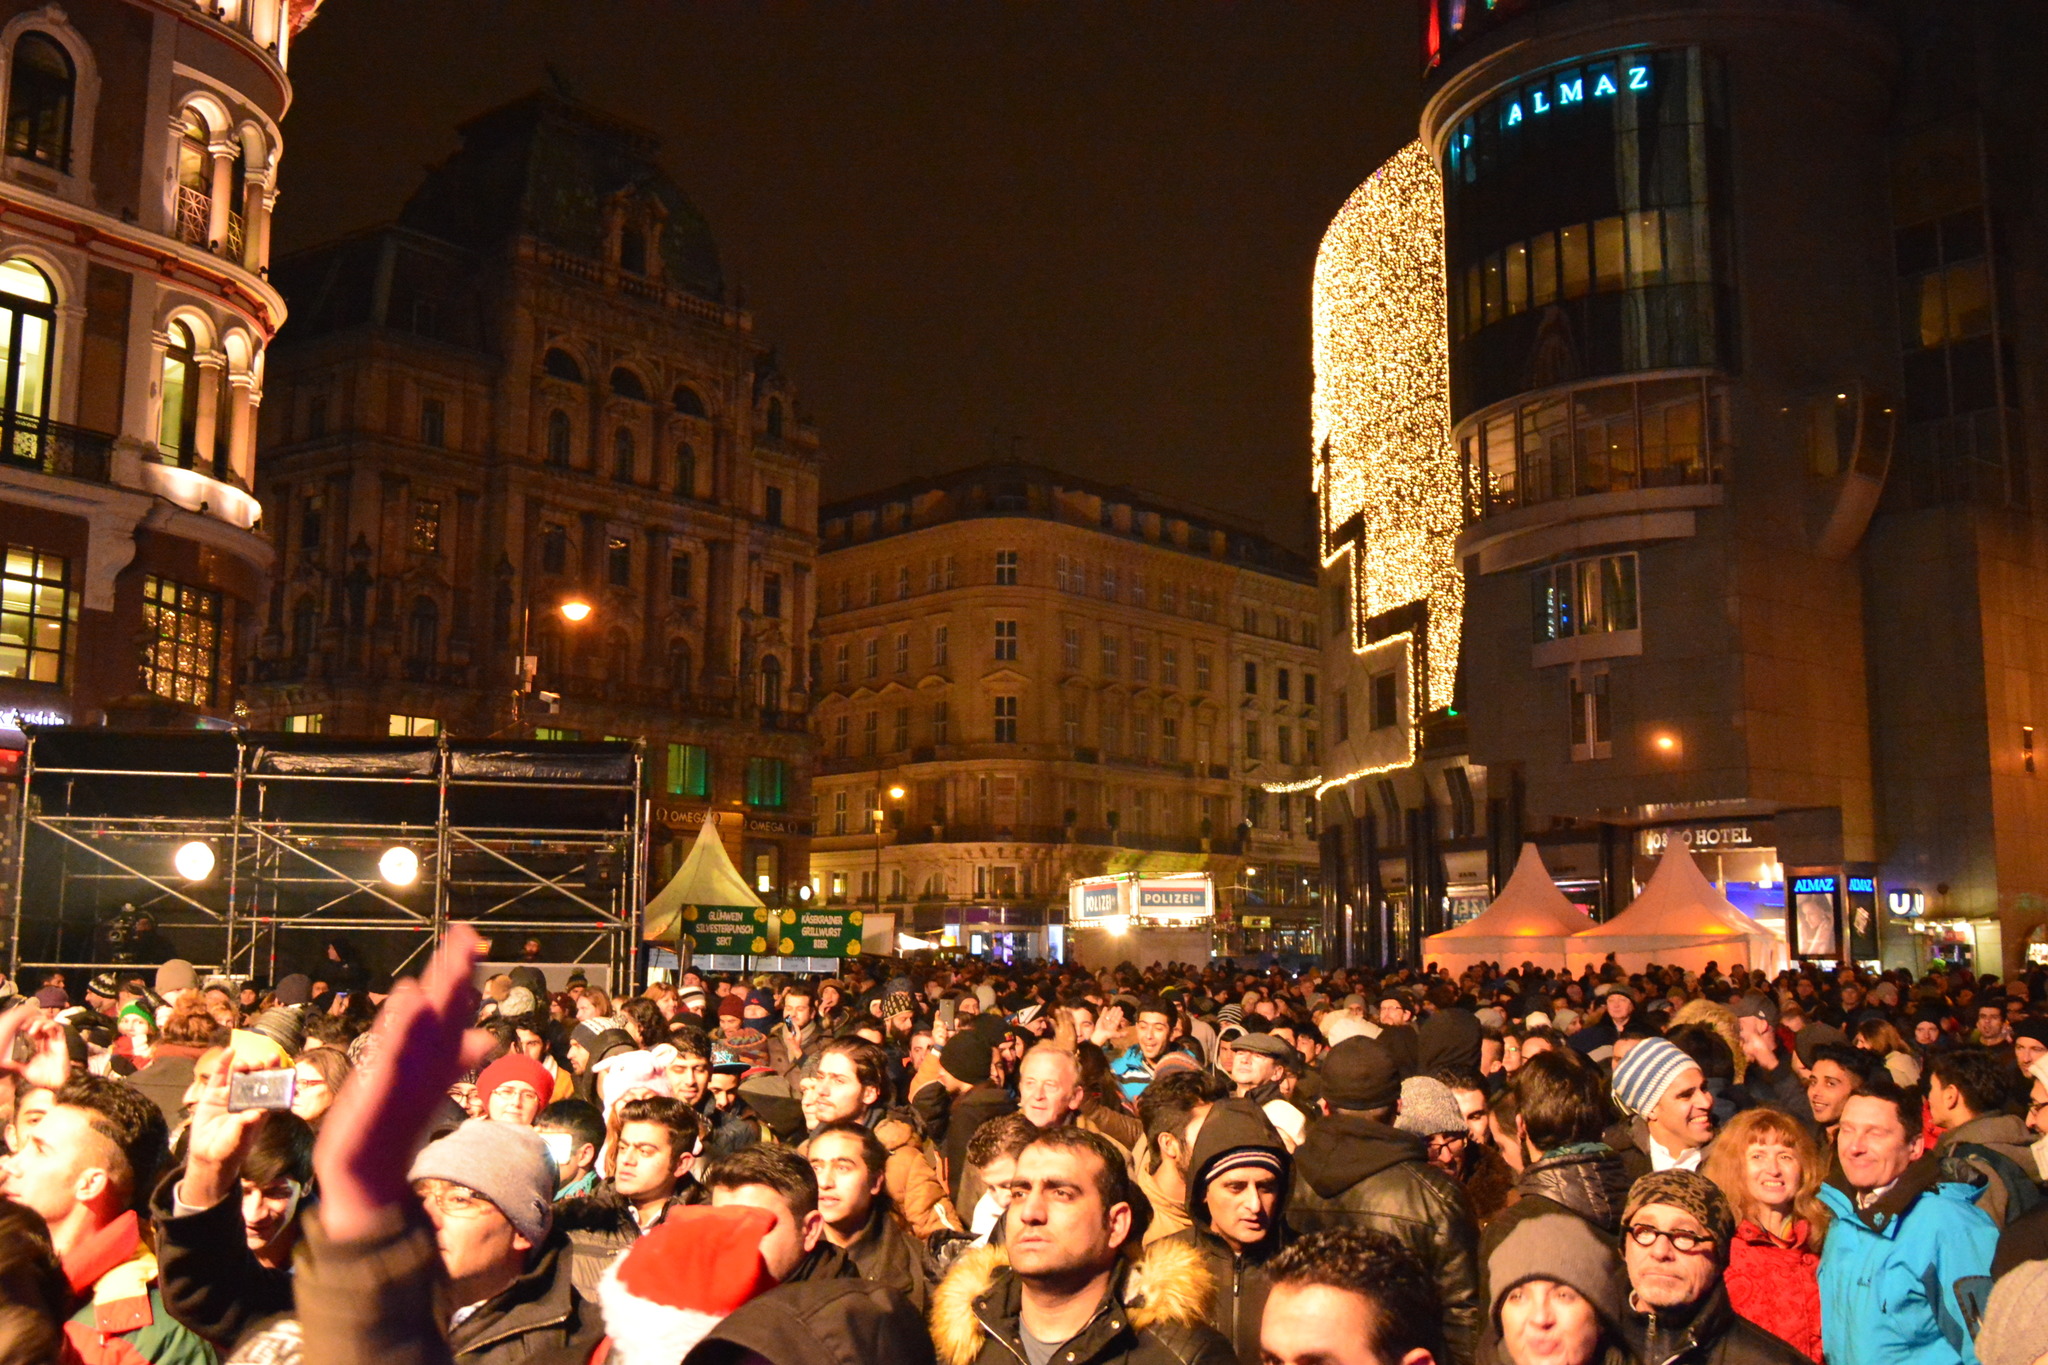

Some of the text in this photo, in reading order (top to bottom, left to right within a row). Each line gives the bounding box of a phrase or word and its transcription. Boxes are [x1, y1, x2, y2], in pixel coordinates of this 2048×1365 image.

[1507, 66, 1649, 126] ALMAZ
[670, 810, 707, 824] OMEGA
[750, 819, 785, 833] OMEGA
[1695, 827, 1752, 845] HOTEL
[1794, 878, 1835, 893] ALMAZ
[1848, 877, 1874, 893] ALMAZ
[1085, 894, 1113, 912] POLIZEI
[1144, 893, 1194, 905] POLIZEI
[1889, 892, 1911, 915] U
[1914, 893, 1925, 915] U
[708, 909, 744, 922] GLÜHWEIN
[801, 912, 844, 926] KÄSEKRAINER
[695, 923, 755, 935] SILVESTERPUNSCH
[801, 926, 842, 938] GRILLWURST
[716, 936, 733, 947] SEKT
[813, 938, 829, 949] BIER
